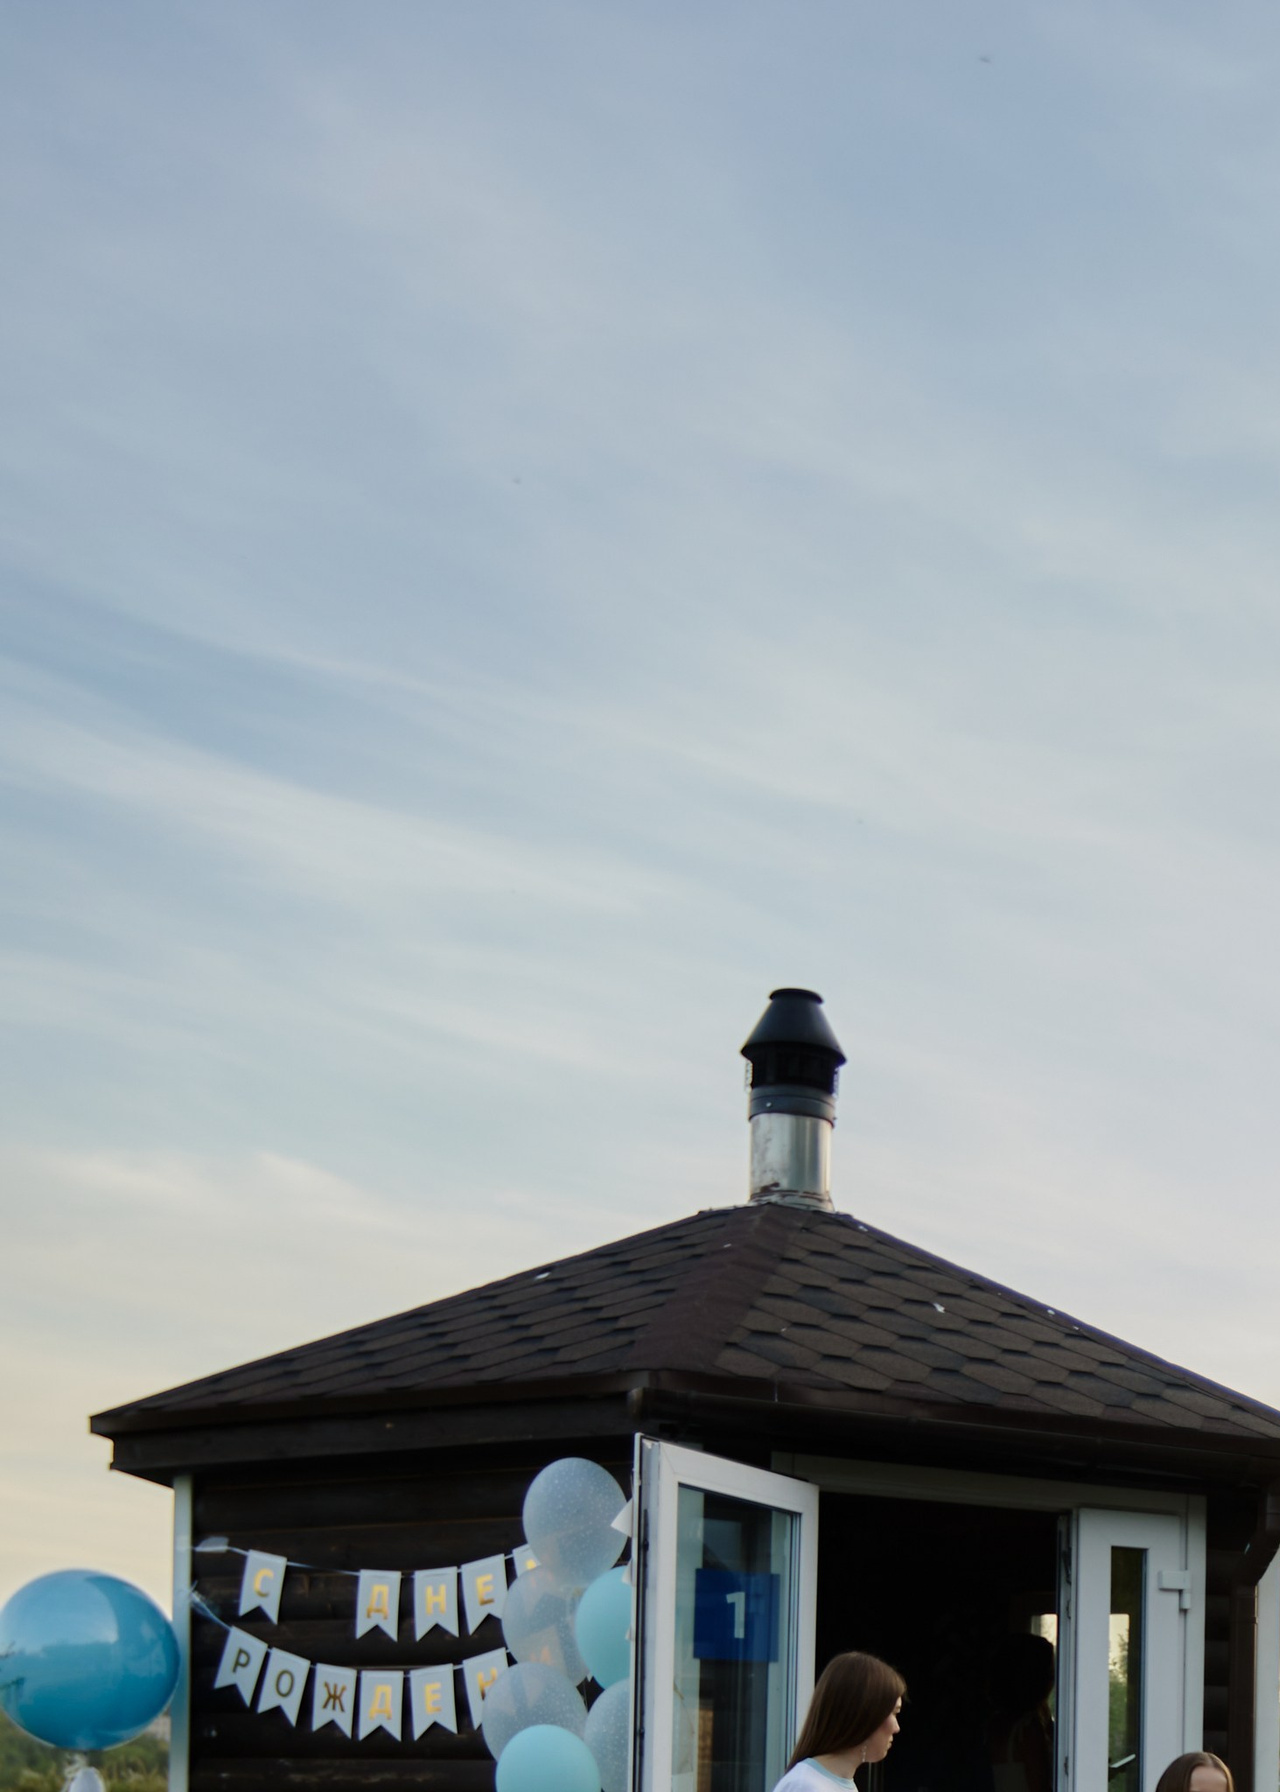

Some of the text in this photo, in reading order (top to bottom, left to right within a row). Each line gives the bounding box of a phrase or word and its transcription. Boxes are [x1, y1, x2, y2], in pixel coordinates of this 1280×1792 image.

[252, 1558, 538, 1621] С ДНЕ
[725, 1591, 746, 1639] 1
[231, 1647, 500, 1721] РОЖДЕН
